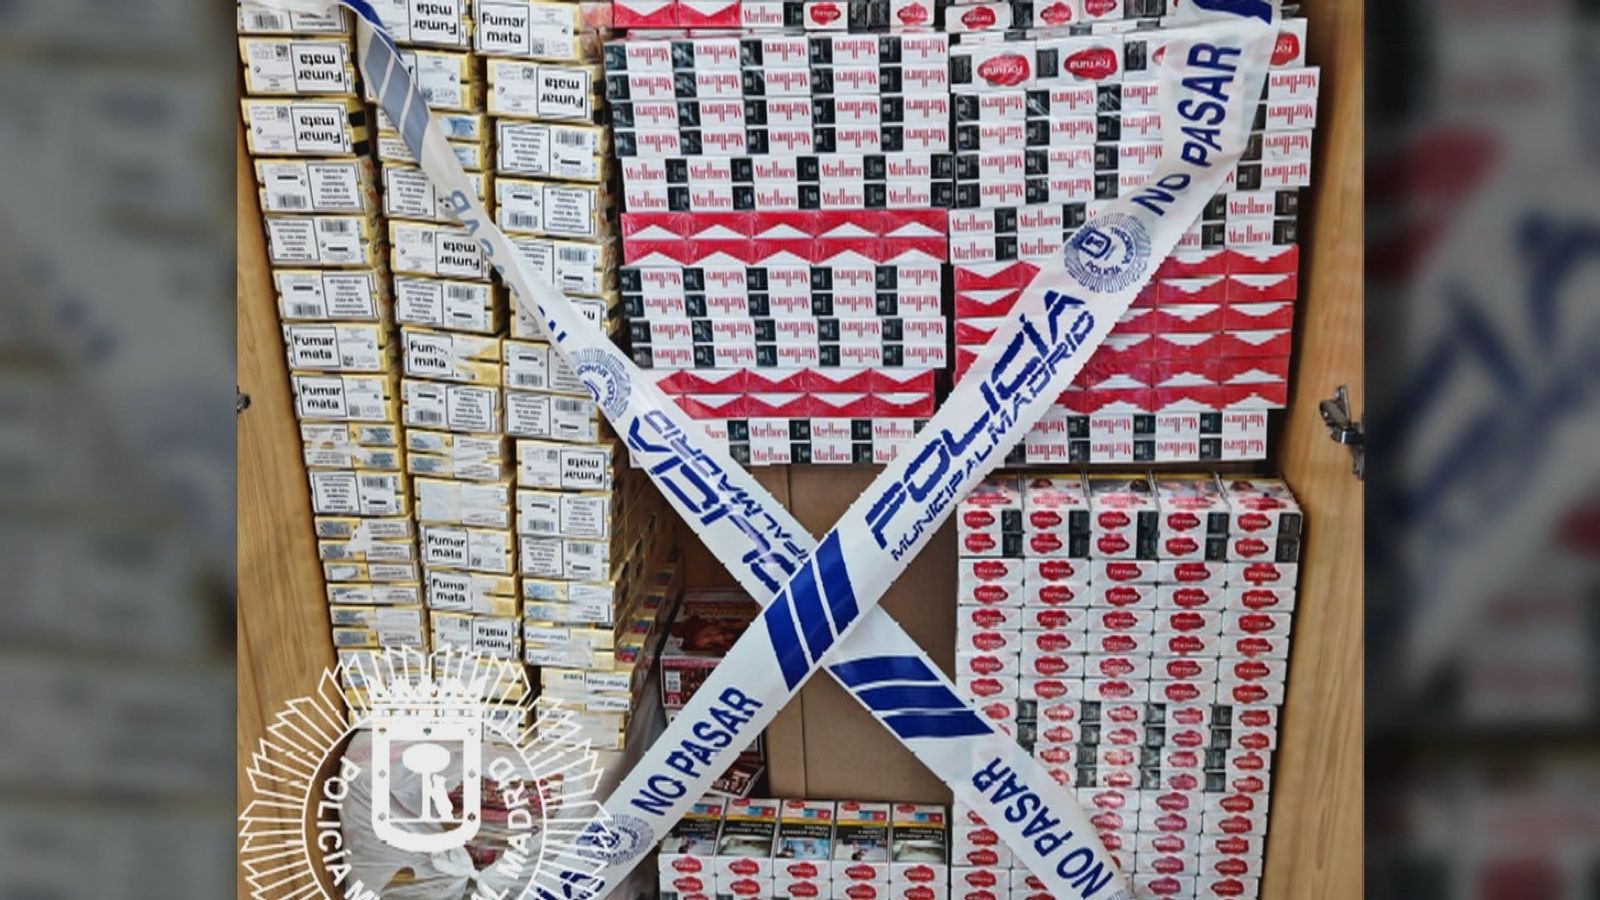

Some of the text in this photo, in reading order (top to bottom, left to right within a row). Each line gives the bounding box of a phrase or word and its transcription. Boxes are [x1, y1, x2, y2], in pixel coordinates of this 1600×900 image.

[417, 4, 452, 15] mata
[742, 8, 783, 25] Marlboro
[480, 12, 525, 27] Fumar
[414, 20, 456, 35] Fumar
[487, 32, 521, 43] mata
[697, 45, 737, 64] Marlboro
[765, 43, 806, 57] Marlboro
[835, 40, 876, 59] Marlboro
[904, 39, 946, 56] Marlboro
[300, 54, 335, 65] mata
[628, 48, 670, 64] Marlboro
[983, 63, 1023, 76] Fortuna
[1070, 58, 1110, 70] Fortuna
[296, 67, 344, 82] Fumar
[766, 72, 808, 89] Marlboro
[836, 70, 877, 86] Marlboro
[905, 70, 945, 85] Marlboro
[545, 78, 579, 89] mata
[633, 76, 672, 93] Marlboro
[698, 74, 741, 91] Marlboro
[1270, 74, 1316, 92] Marlboro
[541, 94, 583, 108] Fumar
[1051, 90, 1093, 107] Marlboro
[1123, 85, 1159, 103] arlboro
[636, 105, 677, 118] Marlboro
[701, 103, 743, 121] Marlboro
[769, 102, 810, 119] Marlboro
[837, 101, 879, 118] Marlboro
[906, 100, 948, 115] Marlboro
[982, 96, 1024, 114] Marlboro
[1269, 104, 1314, 124] Marlboro
[301, 117, 334, 127] mata
[1052, 120, 1095, 138] Marlboro
[1132, 173, 1191, 215] NO
[1177, 43, 1241, 168] PASAR
[299, 128, 343, 144] Fumar
[641, 134, 678, 150] Marlboro
[704, 133, 744, 150] Marlboro
[771, 132, 811, 149] Marlboro
[838, 130, 879, 145] Marlboro
[905, 128, 947, 145] Marlboro
[982, 125, 1024, 144] Marlboro
[1264, 135, 1311, 154] Marlboro
[1120, 144, 1163, 163] Marlboro
[822, 160, 863, 177] Marlboro
[888, 160, 928, 176] Marlboro
[982, 154, 1024, 169] Marlboro
[626, 165, 663, 180] Marlboro
[690, 166, 729, 179] Marlboro
[755, 161, 795, 178] Marlboro
[1264, 164, 1309, 183] Marlboro
[982, 183, 1024, 197] Marlboro
[1051, 178, 1093, 196] Marlboro
[628, 193, 664, 208] Marlboro
[692, 193, 731, 207] Marlboro
[757, 191, 794, 206] Marlboro
[823, 191, 861, 205] Marlboro
[888, 190, 928, 204] Marlboro
[1229, 196, 1271, 214] Marlboro
[950, 214, 994, 232] Marlboro
[1020, 213, 1060, 226] Marlboro
[1227, 225, 1271, 243] Marlboro
[443, 242, 475, 252] mata
[953, 243, 992, 259] Marlboro
[440, 256, 480, 270] Fumar
[642, 271, 681, 287] Marlboro
[707, 271, 744, 287] Marlboro
[772, 270, 809, 285] Marlboro
[837, 269, 874, 285] Marlboro
[902, 268, 939, 283] Marlboro
[645, 298, 684, 311] Marlboro
[710, 295, 747, 310] Marlboro
[772, 296, 811, 309] Marlboro
[836, 295, 874, 310] Marlboro
[900, 294, 939, 310] Marlboro
[655, 324, 690, 336] Marlboro
[714, 321, 753, 337] Marlboro
[778, 321, 816, 334] Marlboro
[842, 321, 880, 336] Marlboro
[906, 320, 944, 336] Marlboro
[295, 335, 333, 348] Fumar
[300, 349, 332, 359] mata
[656, 349, 692, 362] Marlboro
[717, 347, 754, 362] Marlboro
[780, 347, 817, 359] Marlboro
[842, 347, 881, 361] Marlboro
[906, 347, 944, 362] Marlboro
[415, 358, 446, 368] mata
[300, 385, 343, 395] Fumar
[308, 399, 339, 409] mata
[865, 290, 1085, 550] POLICÍA
[1089, 415, 1131, 432] Marlboro
[1158, 412, 1199, 431] Marlboro
[1225, 413, 1264, 427] Marlboro
[752, 425, 787, 438] Marlboro
[811, 423, 852, 438] Marlboro
[1028, 444, 1066, 460] Marlboro
[1093, 442, 1133, 455] Marlboro
[1160, 441, 1198, 454] Marlboro
[1226, 439, 1264, 453] Marlboro
[753, 449, 787, 462] Marlboro
[814, 447, 848, 461] Marlboro
[568, 459, 599, 468] mata
[565, 471, 605, 483] Fumar
[628, 416, 797, 594] OLICÍA
[428, 535, 465, 548] Fumar
[432, 546, 462, 559] mata
[436, 592, 465, 602] mata
[479, 627, 507, 636] mata
[476, 639, 513, 651] Fumar
[631, 773, 686, 813] NO
[665, 686, 762, 777] PASAR
[971, 757, 1112, 899] NO PASAR
